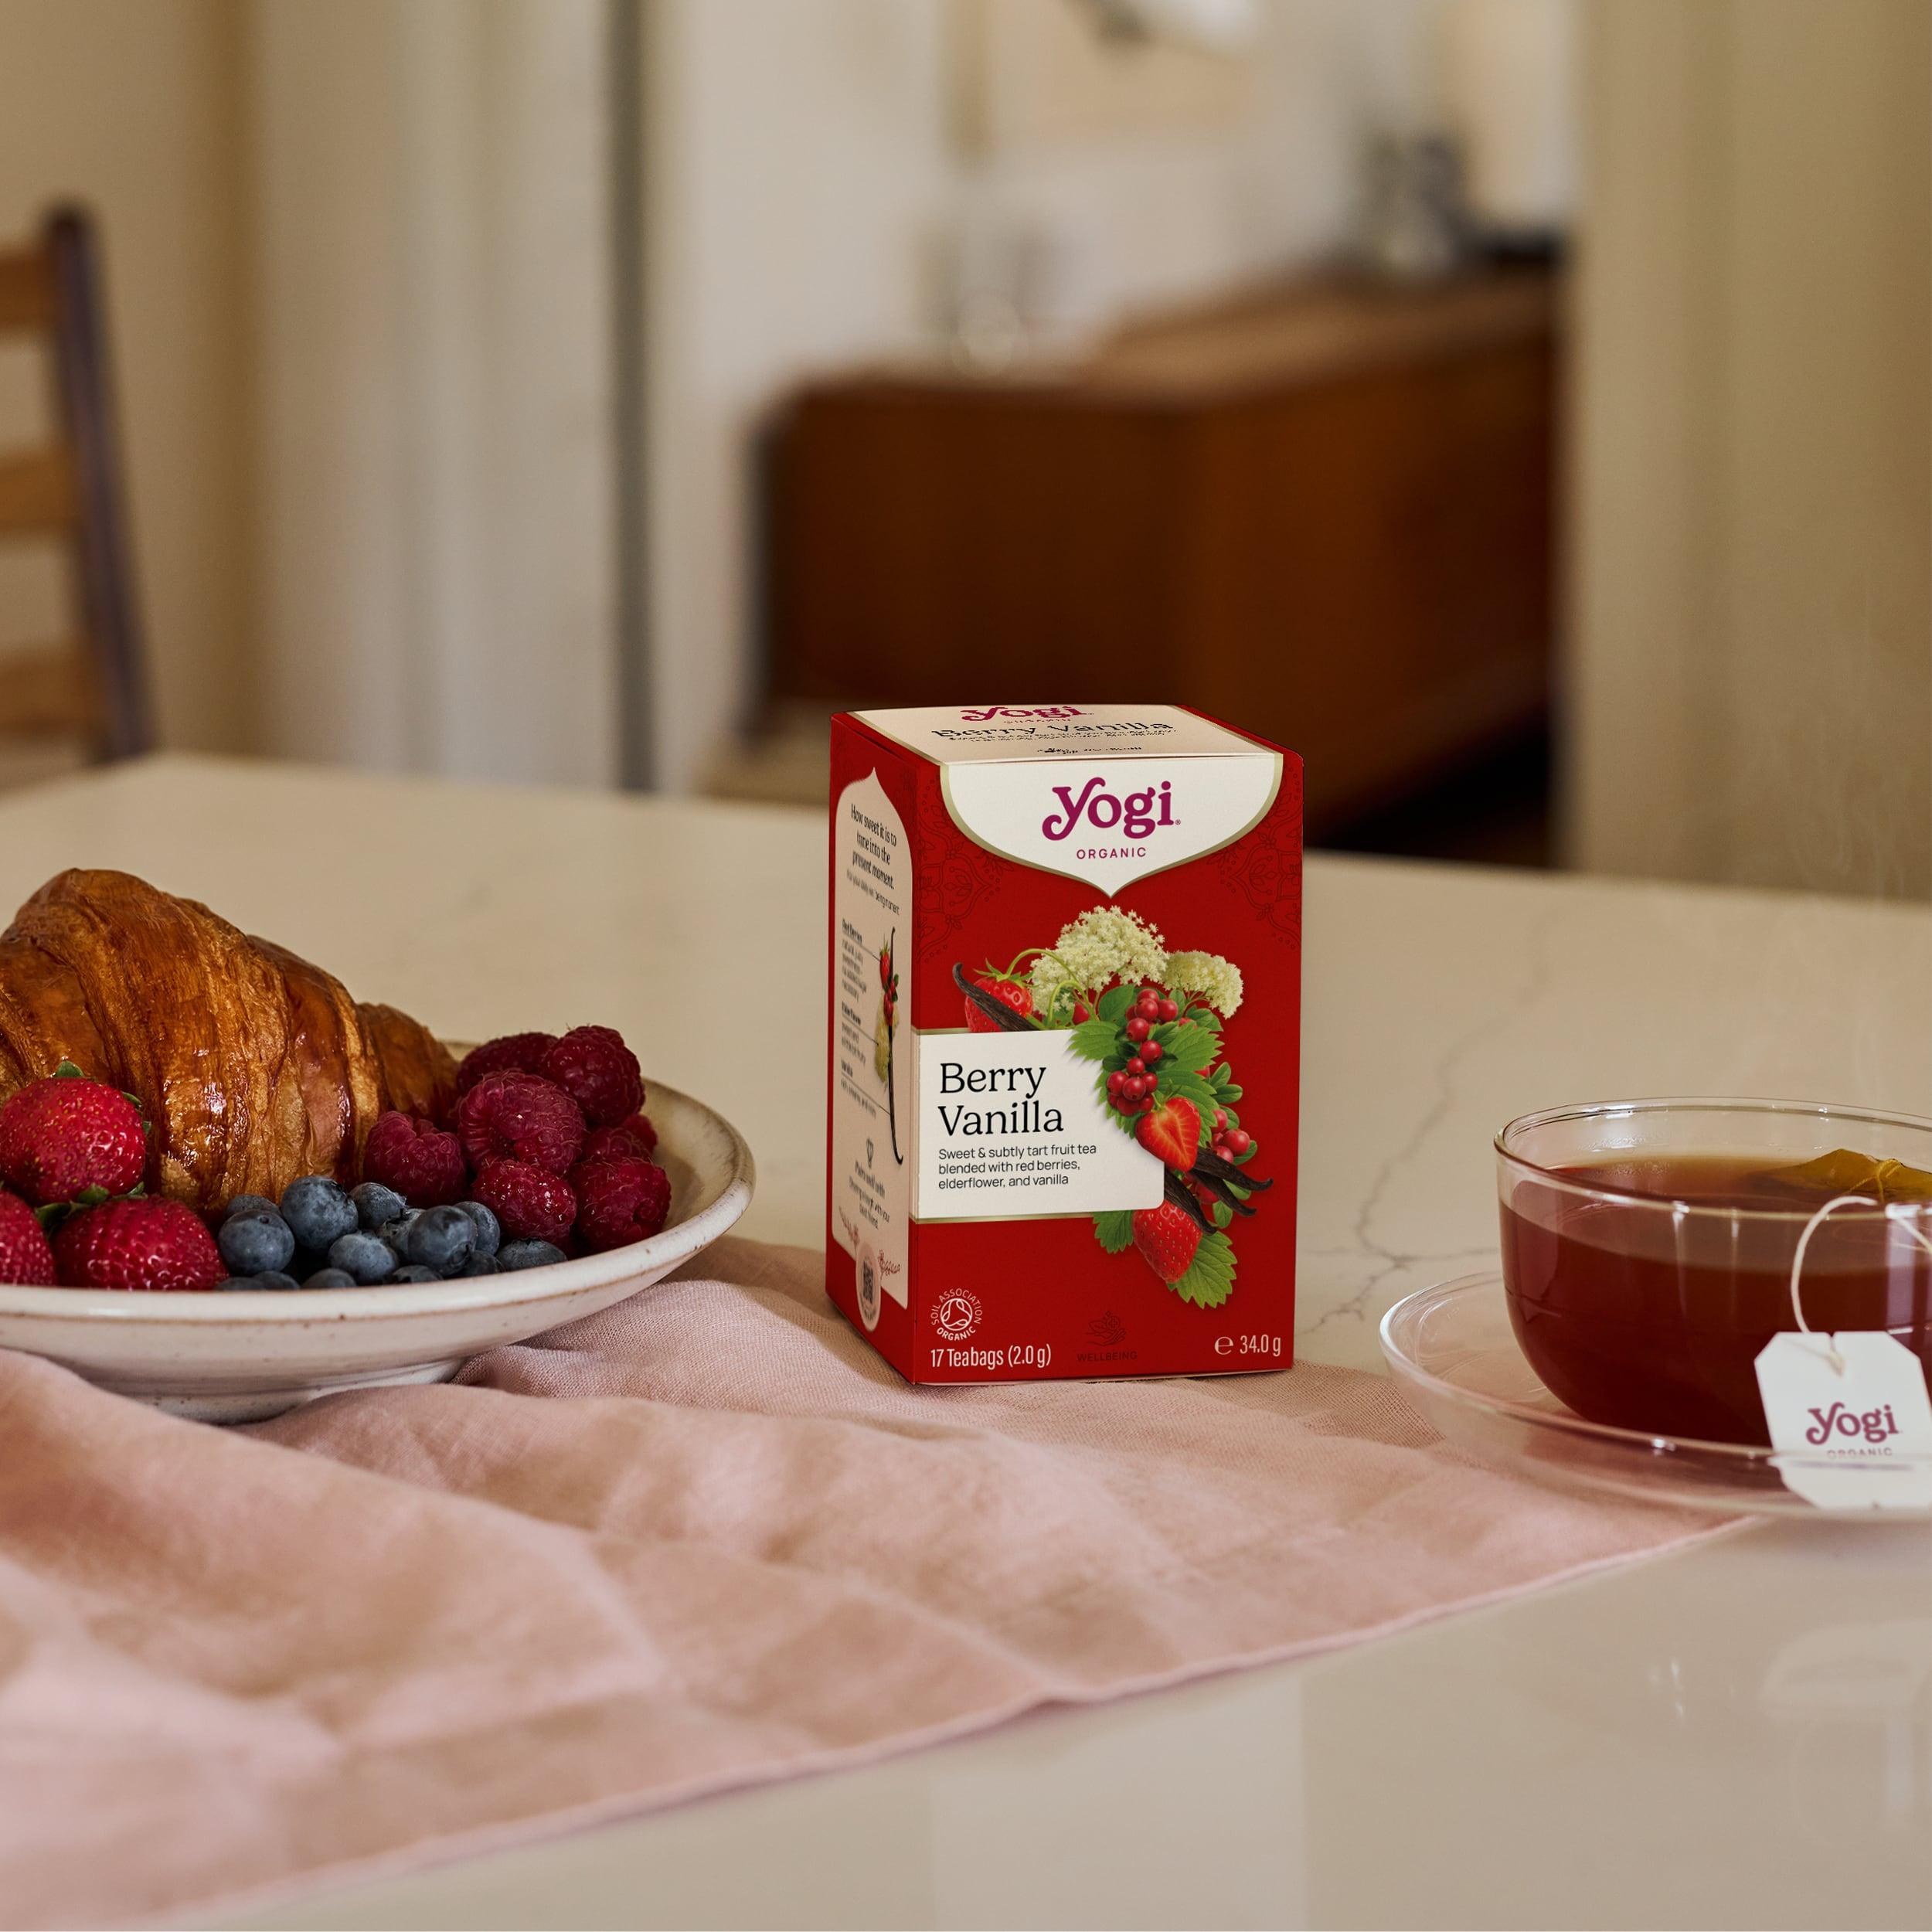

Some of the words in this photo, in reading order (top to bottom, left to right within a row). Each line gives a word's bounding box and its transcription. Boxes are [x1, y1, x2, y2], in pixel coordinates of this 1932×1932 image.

[931, 728, 1036, 737] Berry
[1047, 723, 1173, 732] Vanilla
[864, 815, 879, 836] sweet
[881, 845, 890, 865] the
[1077, 846, 1147, 859] ORGANIC
[940, 1063, 1046, 1099] Berry
[937, 1100, 1064, 1136] Vanilla
[938, 1148, 975, 1160] Sweet
[978, 1148, 986, 1158] &
[988, 1146, 1025, 1159] subtly
[1027, 1145, 1048, 1156] tart
[1051, 1144, 1076, 1155] fruit
[1078, 1144, 1097, 1154] tea
[938, 1163, 986, 1175] blended
[988, 1162, 1013, 1173] with
[1015, 1161, 1035, 1172] red
[1037, 1160, 1080, 1172] berries,
[938, 1177, 1005, 1189] elderflower,
[1009, 1175, 1030, 1186] and
[1033, 1174, 1069, 1185] vanilla
[931, 1304, 940, 1325] SOIL
[938, 1288, 983, 1325] ASSOCIATION
[937, 1326, 976, 1341] ORGANIC
[1240, 1334, 1269, 1354] 34.0
[1273, 1336, 1281, 1356] g
[931, 1349, 944, 1367] 17
[947, 1346, 1004, 1370] Teabags
[1008, 1345, 1034, 1367] (2.0
[1037, 1343, 1052, 1368] g)
[1077, 1352, 1138, 1362] WELLBEING
[1827, 1447, 1893, 1460] ORGANIC
